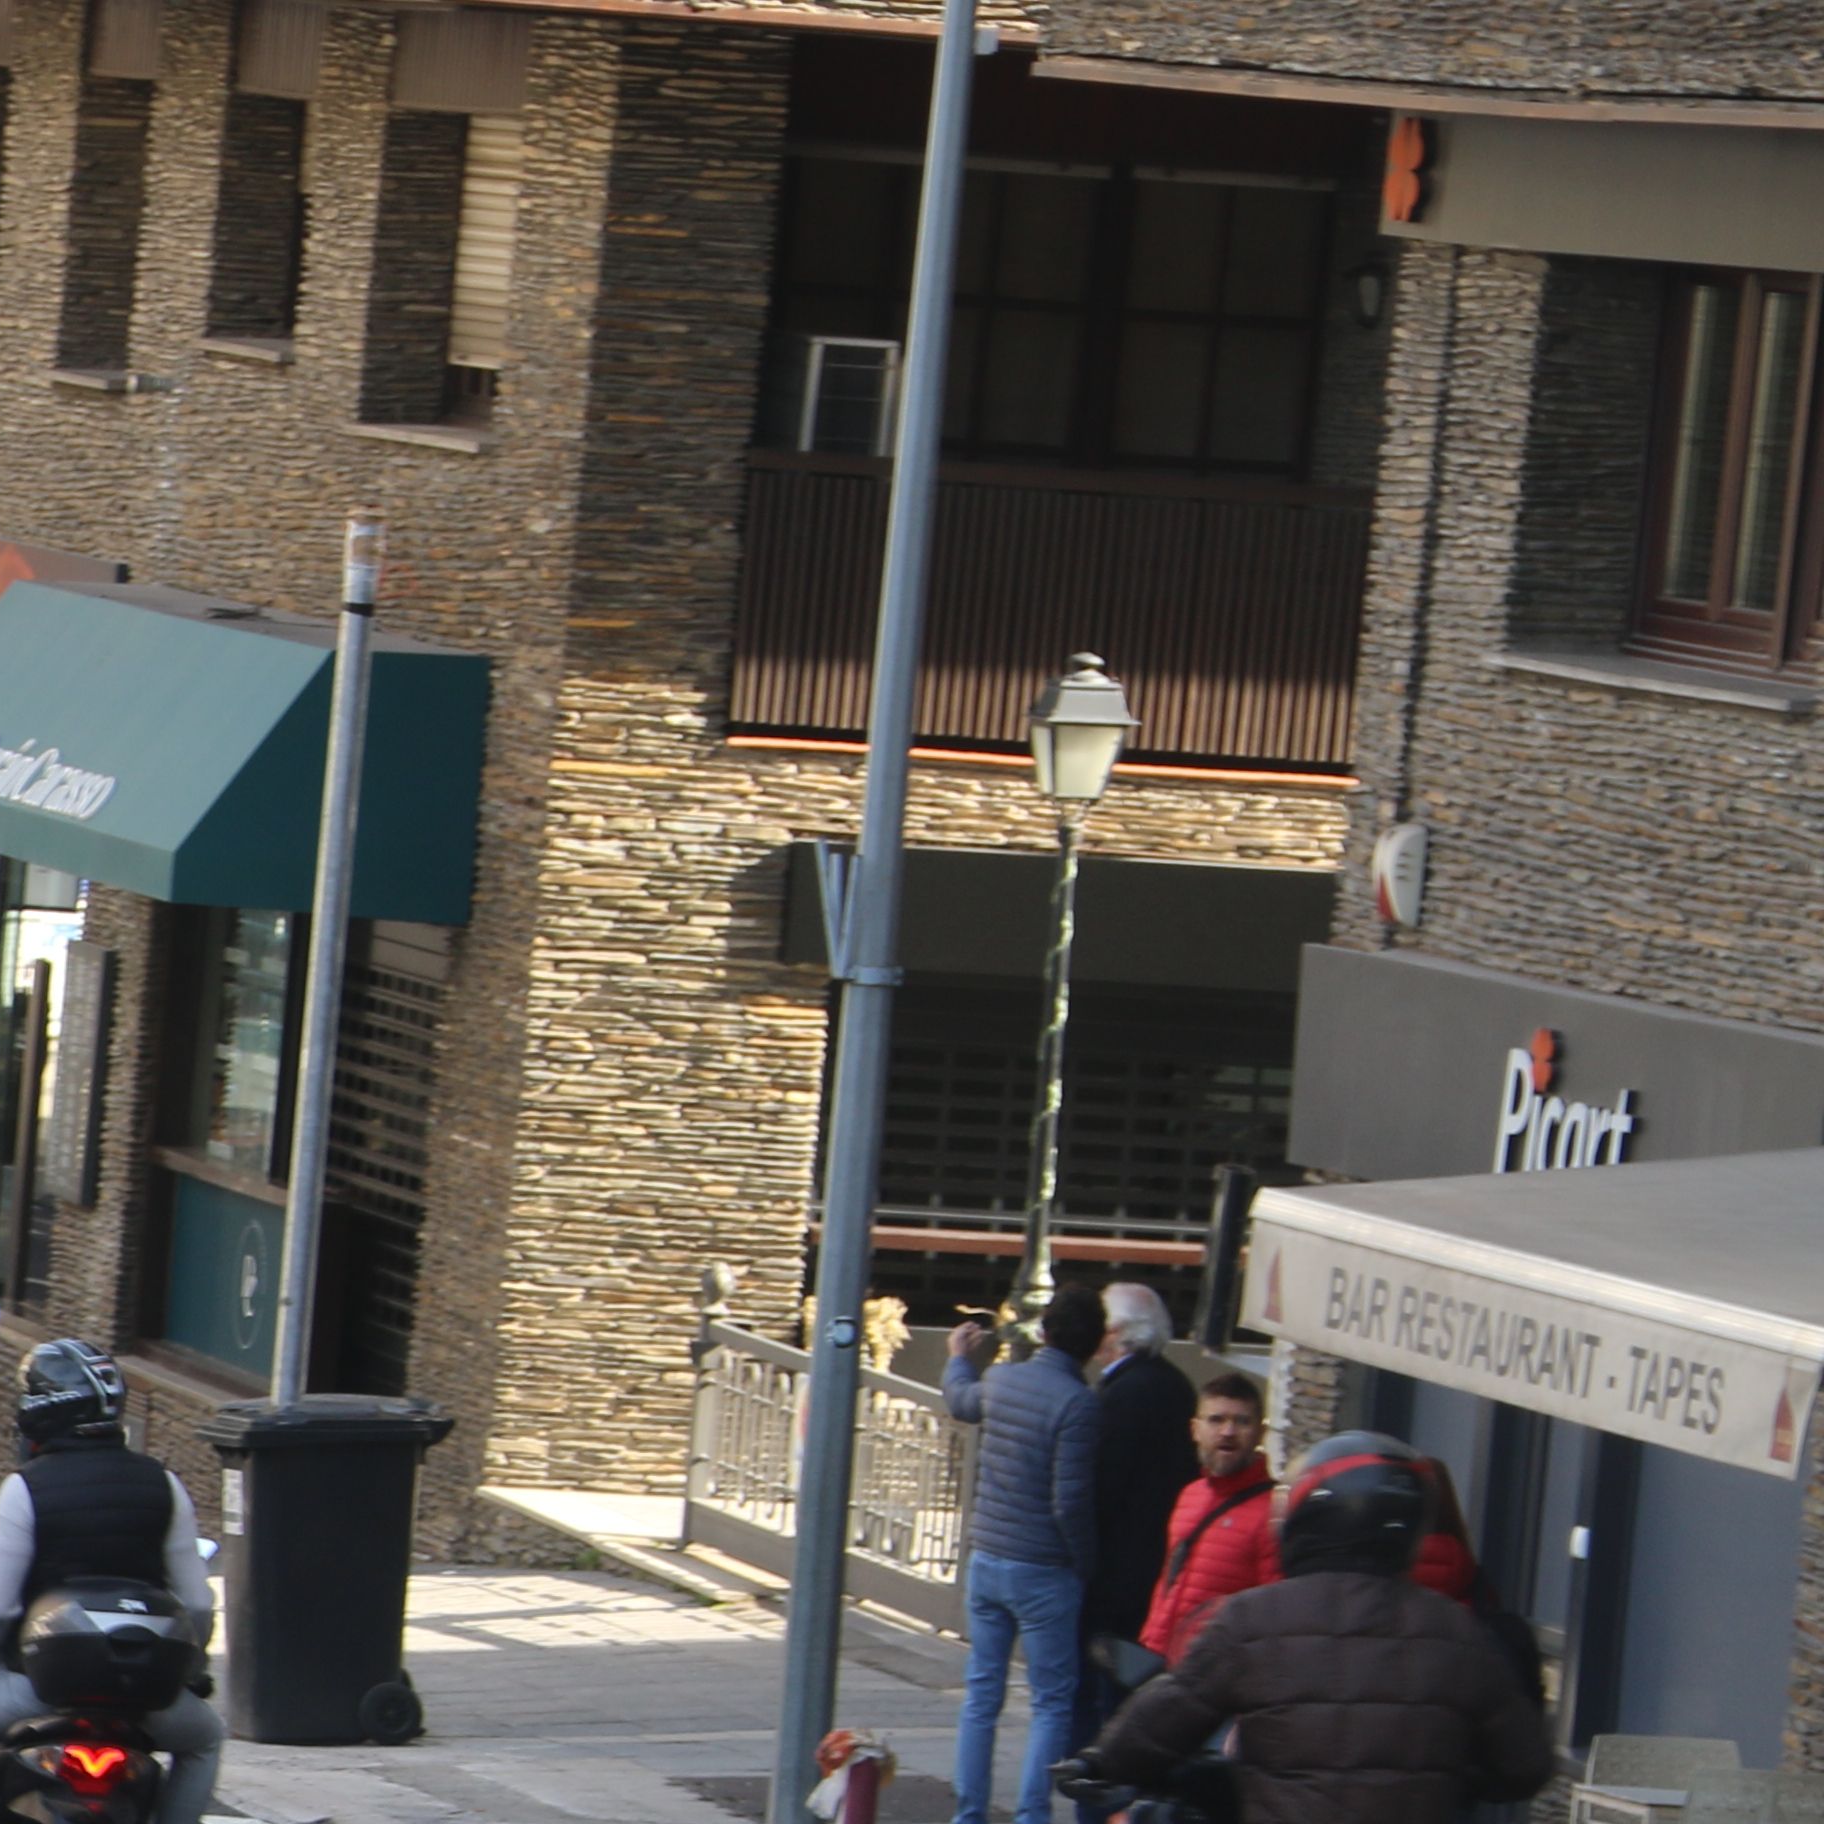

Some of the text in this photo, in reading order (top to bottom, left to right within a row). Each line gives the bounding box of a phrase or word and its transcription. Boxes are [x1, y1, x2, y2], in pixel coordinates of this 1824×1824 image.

[1325, 1267, 1389, 1343] BAR
[1395, 1286, 1601, 1399] RESTAURANT
[1627, 1346, 1725, 1436] TAPES
